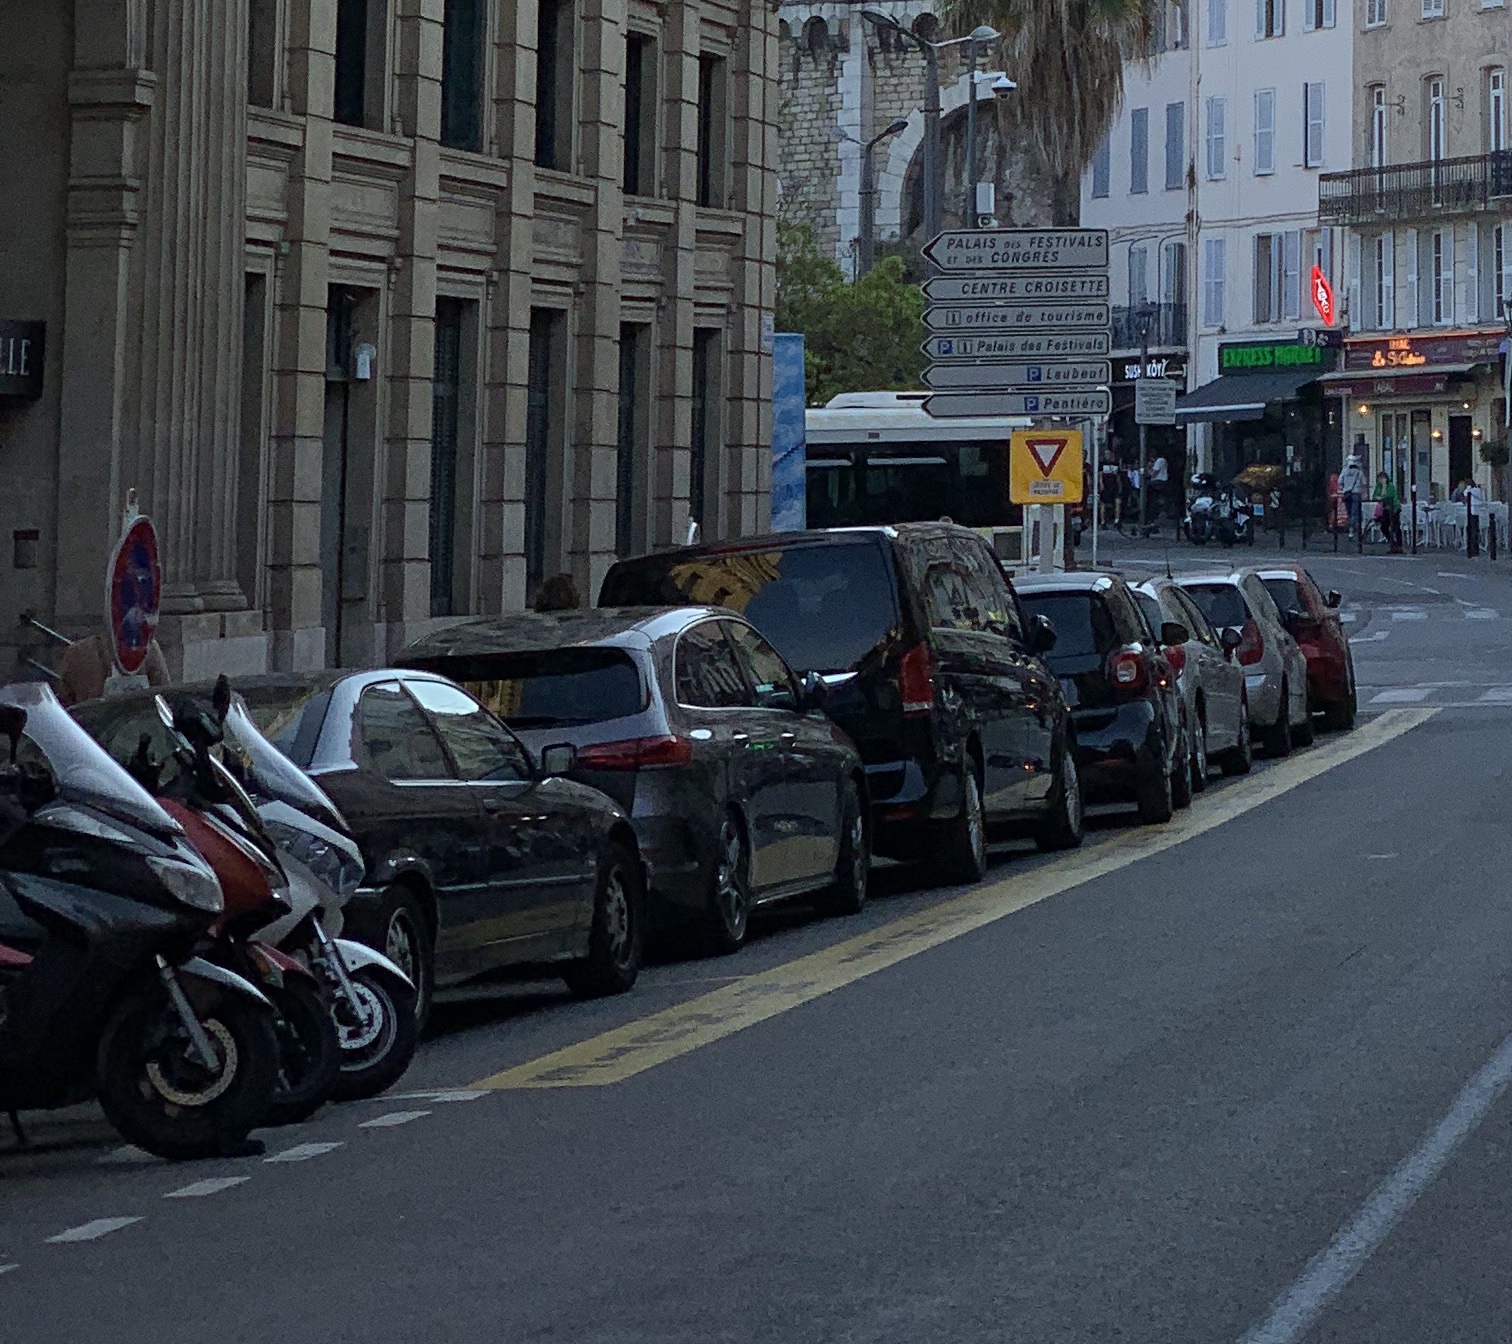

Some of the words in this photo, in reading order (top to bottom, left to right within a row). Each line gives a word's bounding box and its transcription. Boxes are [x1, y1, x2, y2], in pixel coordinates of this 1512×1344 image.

[946, 237, 997, 250] PALAIS
[1029, 235, 1104, 248] FESTIVALS
[961, 282, 1017, 295] CENTRE
[1024, 280, 1104, 293] CROISETTE
[966, 312, 1008, 324] office
[1015, 312, 1032, 323] de
[1041, 311, 1104, 323] tourisme
[977, 340, 1016, 353] Palais
[1020, 339, 1042, 352] des
[1046, 338, 1104, 351] Festivals
[1046, 367, 1105, 380] Laubeuf
